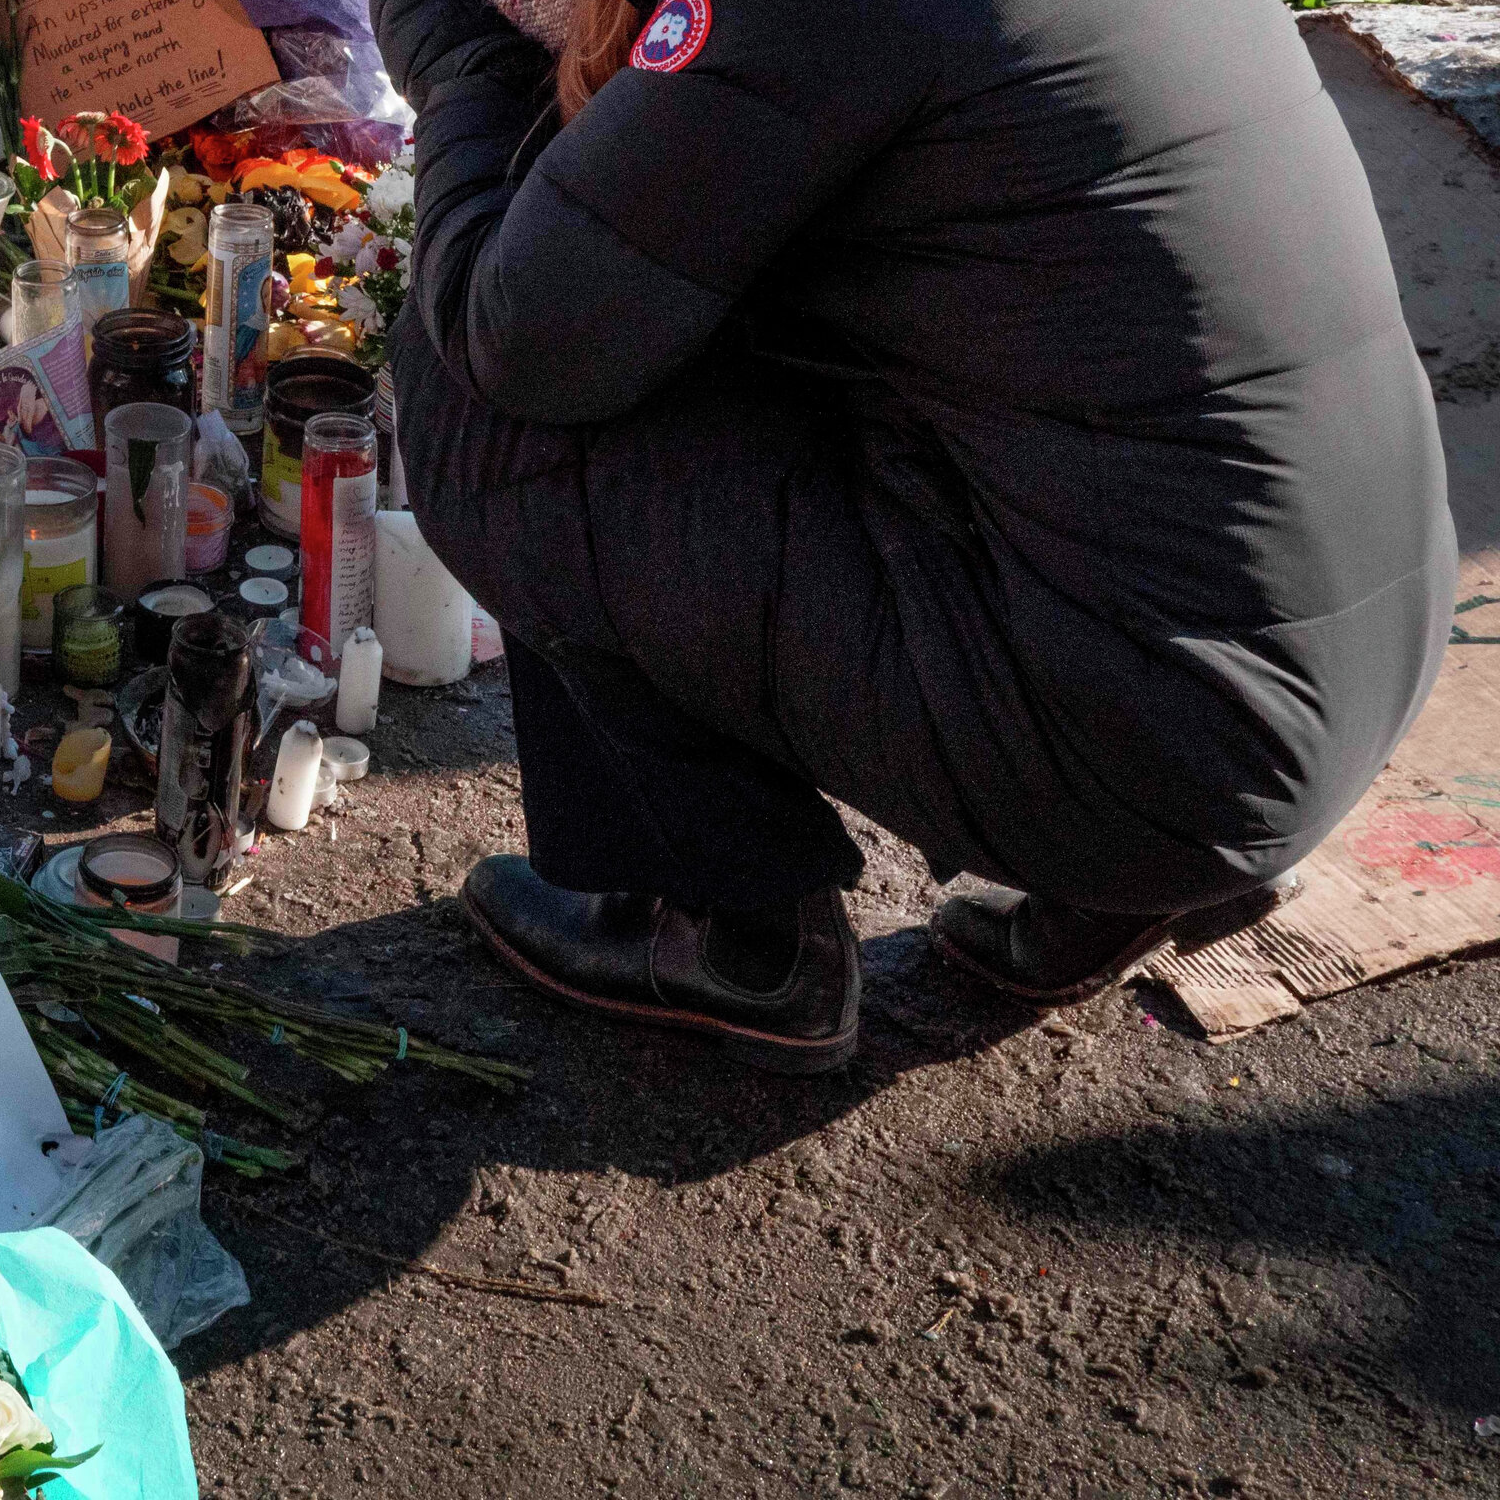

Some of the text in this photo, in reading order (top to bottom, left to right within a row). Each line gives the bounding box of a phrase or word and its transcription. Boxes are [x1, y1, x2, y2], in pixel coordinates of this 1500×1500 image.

[26, 15, 58, 41] An
[33, 25, 102, 66] Murdered
[104, 15, 125, 33] for
[61, 20, 164, 75] a helping hand
[51, 36, 183, 106] He is true north
[116, 49, 227, 115] hold the line!
